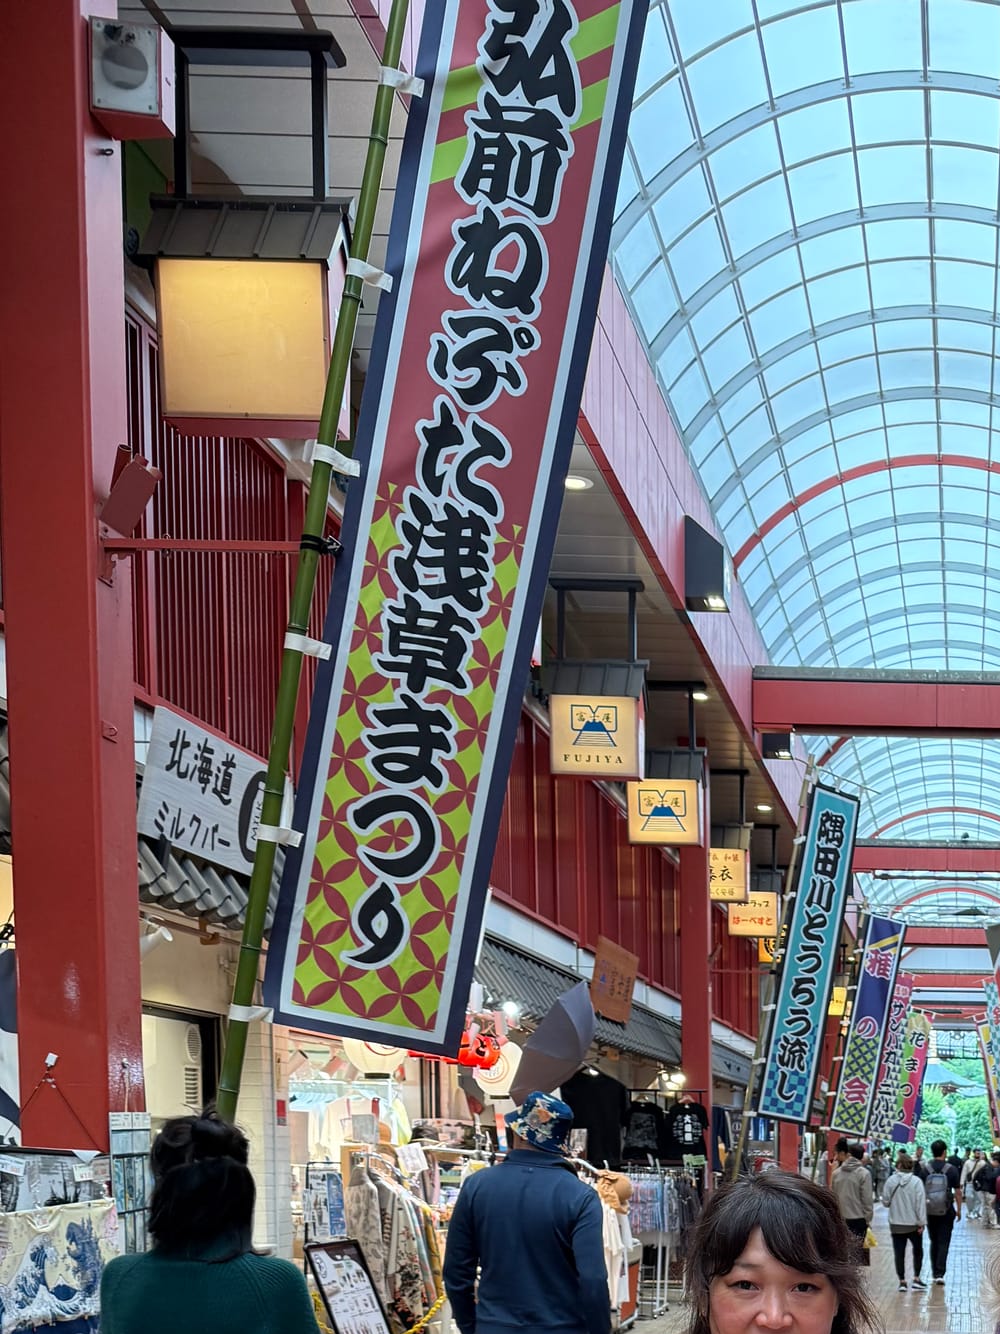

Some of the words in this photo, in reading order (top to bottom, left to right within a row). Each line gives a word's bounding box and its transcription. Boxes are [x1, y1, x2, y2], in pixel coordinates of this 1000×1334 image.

[165, 728, 236, 806] 北海道
[563, 753, 623, 764] FUJIYA
[154, 801, 230, 851] ミルクバー
[778, 810, 845, 1101] 隅田川とうろう流し
[843, 950, 892, 1104] 雅の会
[871, 999, 904, 1129] サンバカーニバル
